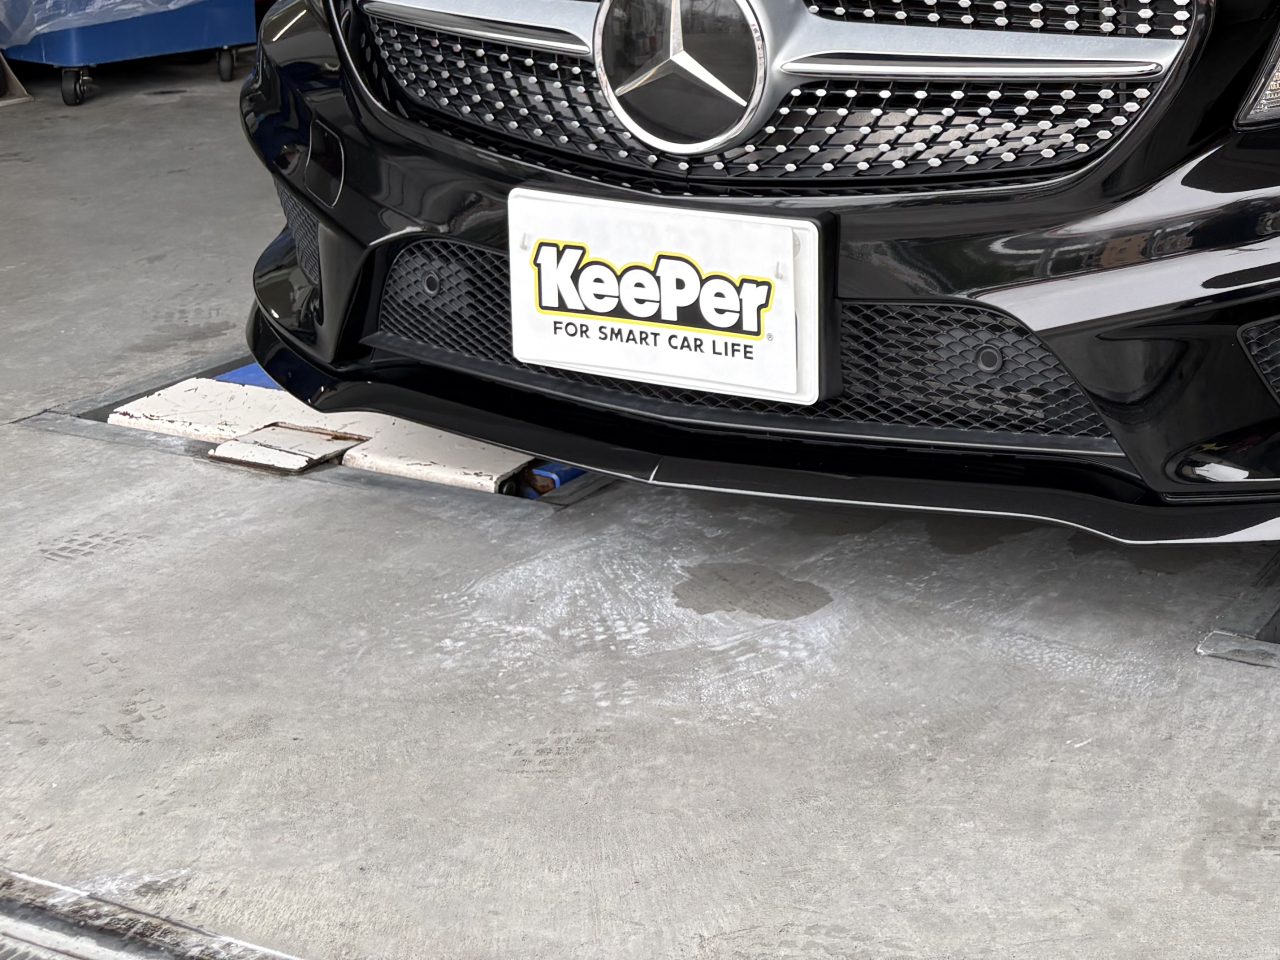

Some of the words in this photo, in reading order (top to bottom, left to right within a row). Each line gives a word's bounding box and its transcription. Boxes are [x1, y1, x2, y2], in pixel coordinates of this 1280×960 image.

[531, 240, 775, 339] KeePer
[553, 320, 591, 340] FOR
[598, 325, 661, 348] SMART
[668, 333, 705, 354] CAR
[712, 340, 754, 361] LIFE
